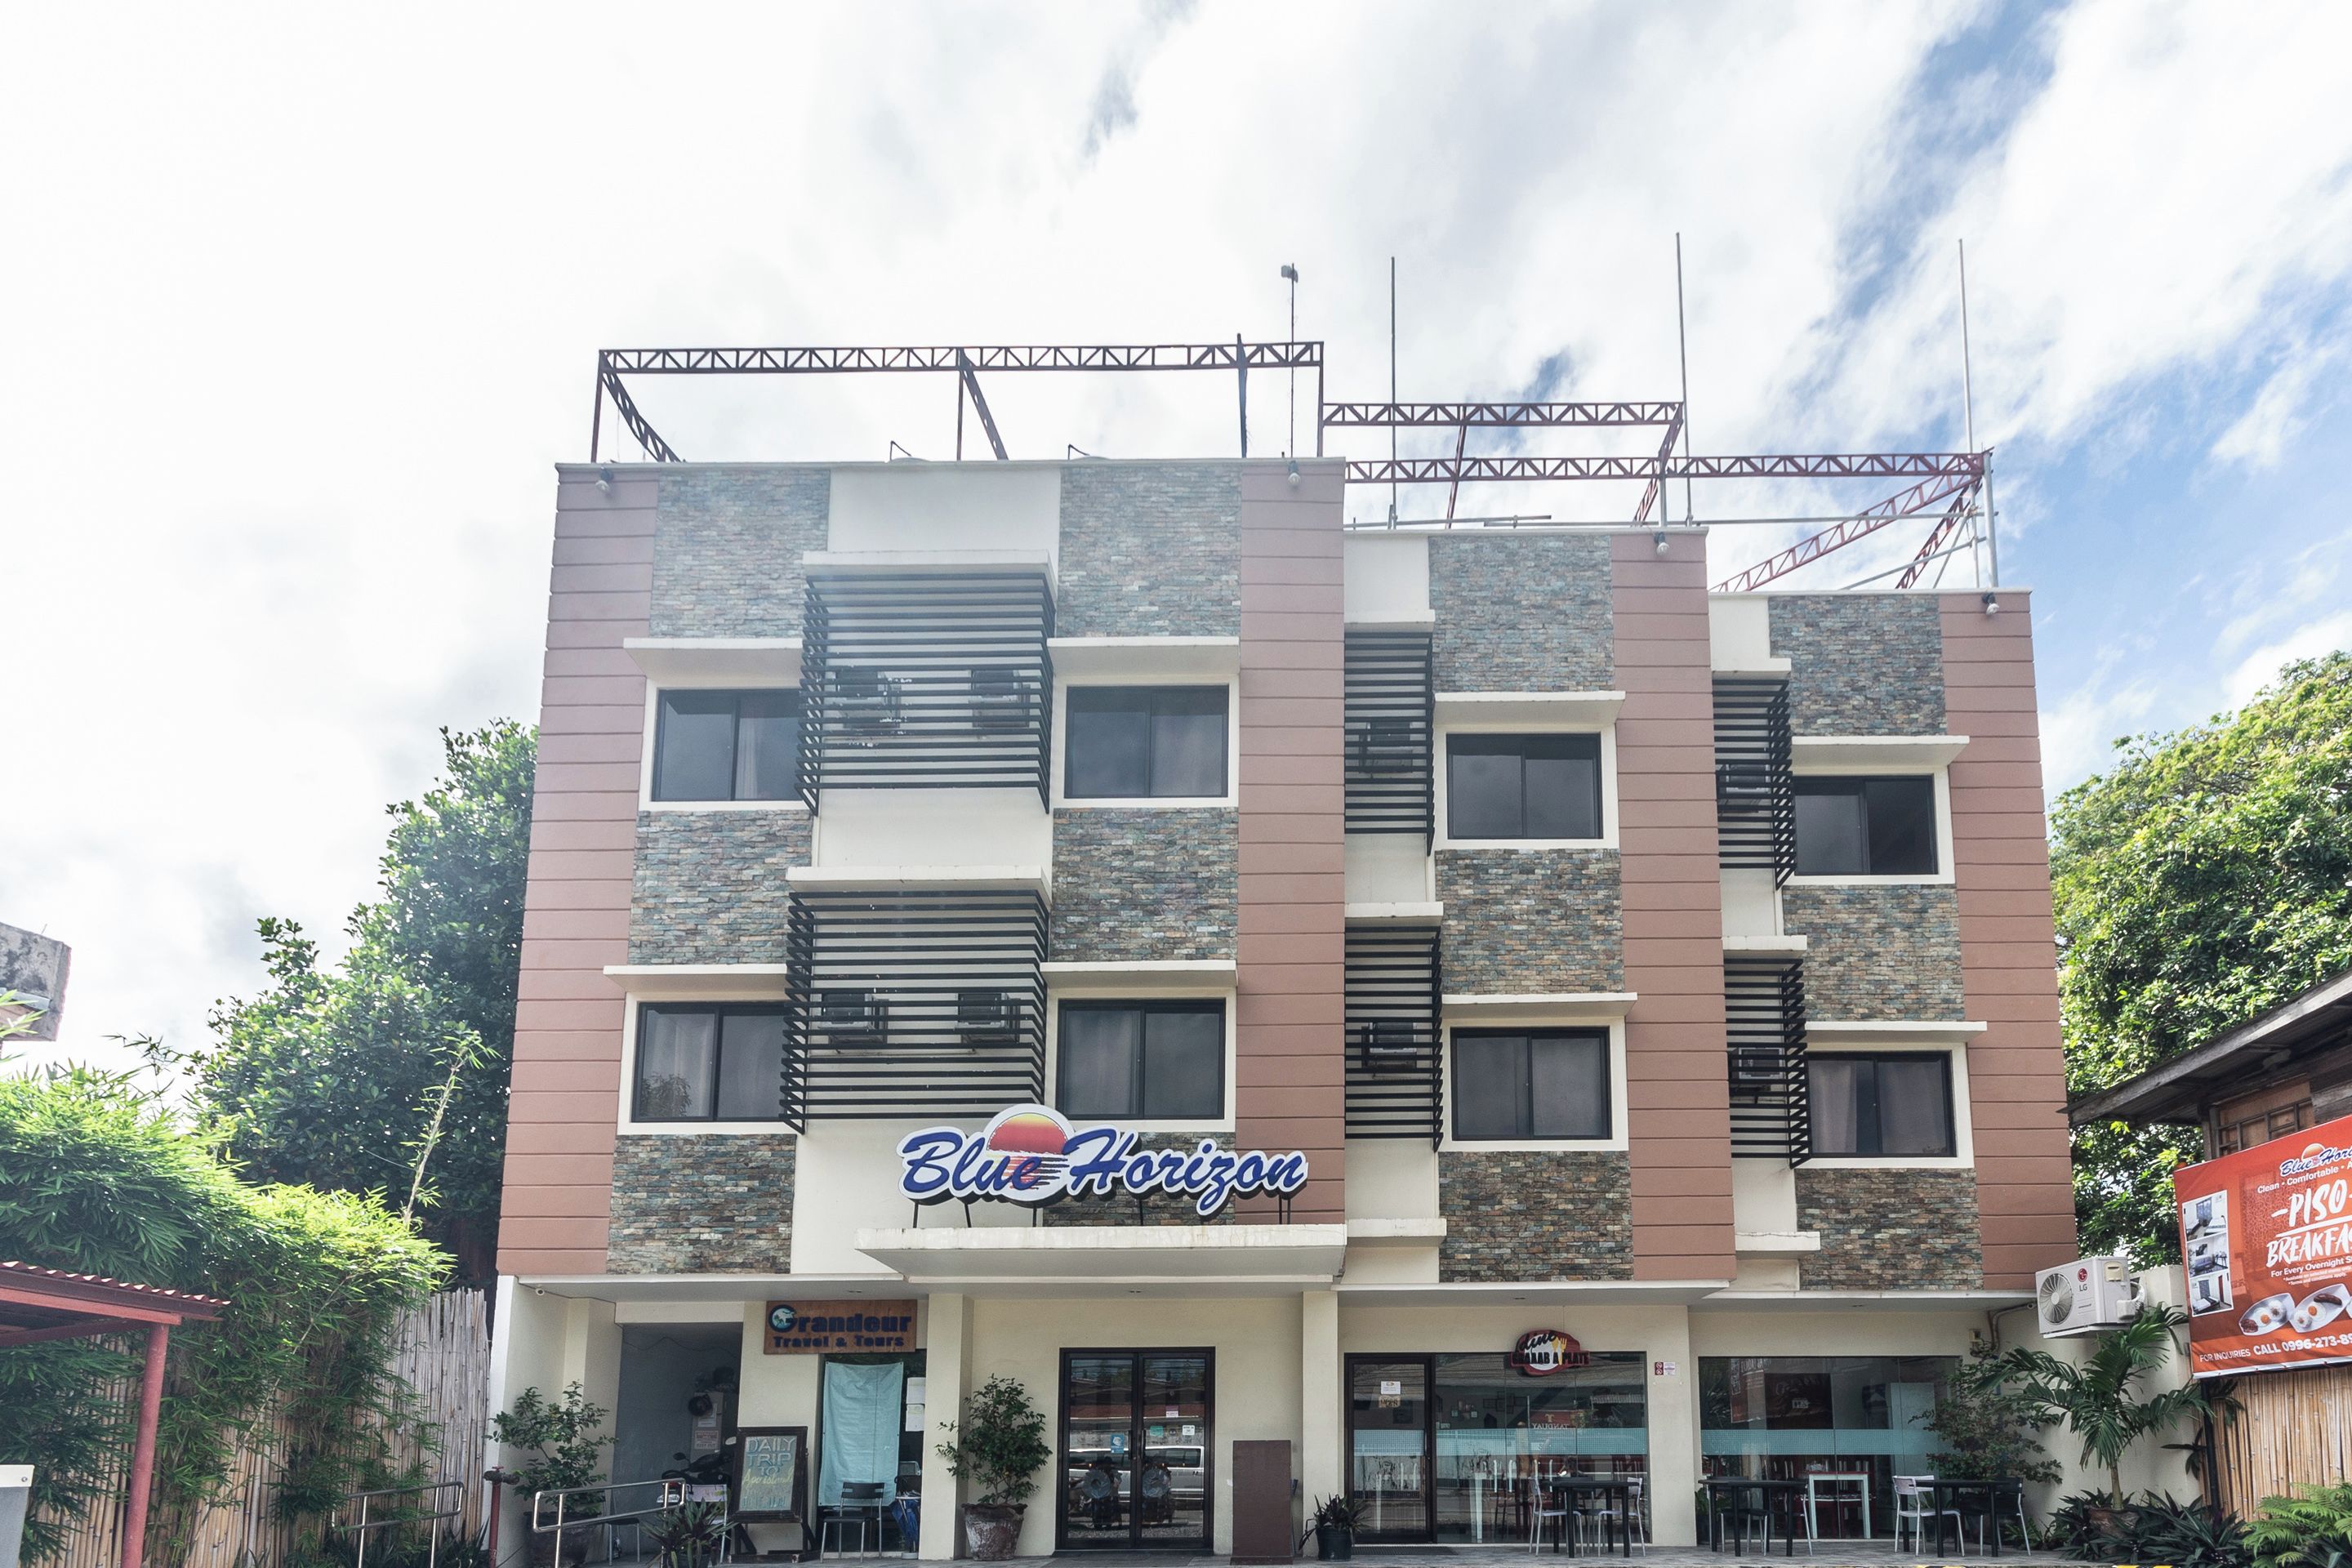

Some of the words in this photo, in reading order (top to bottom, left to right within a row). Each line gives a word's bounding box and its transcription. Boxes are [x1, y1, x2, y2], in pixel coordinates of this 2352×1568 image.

[902, 1130, 1042, 1192] Blue
[1062, 1128, 1307, 1211] Horizon
[2281, 1160, 2312, 1175] Blue
[2257, 1183, 2279, 1193] Clean
[2287, 1166, 2339, 1185] Comfortable
[2283, 1266, 2304, 1276] Every
[2305, 1258, 2345, 1271] Overnight
[768, 1304, 912, 1333] Grandeur
[773, 1336, 830, 1348] Travel
[835, 1337, 847, 1347] &
[854, 1335, 905, 1347] Tours
[1552, 1352, 1559, 1365] A
[1561, 1352, 1590, 1365] PLATE
[2199, 1353, 2213, 1362] FOR
[2214, 1348, 2252, 1361] INQUIRIES
[2253, 1343, 2281, 1356] CALL
[746, 1437, 795, 1452] DAILY
[747, 1453, 792, 1467] TRIP
